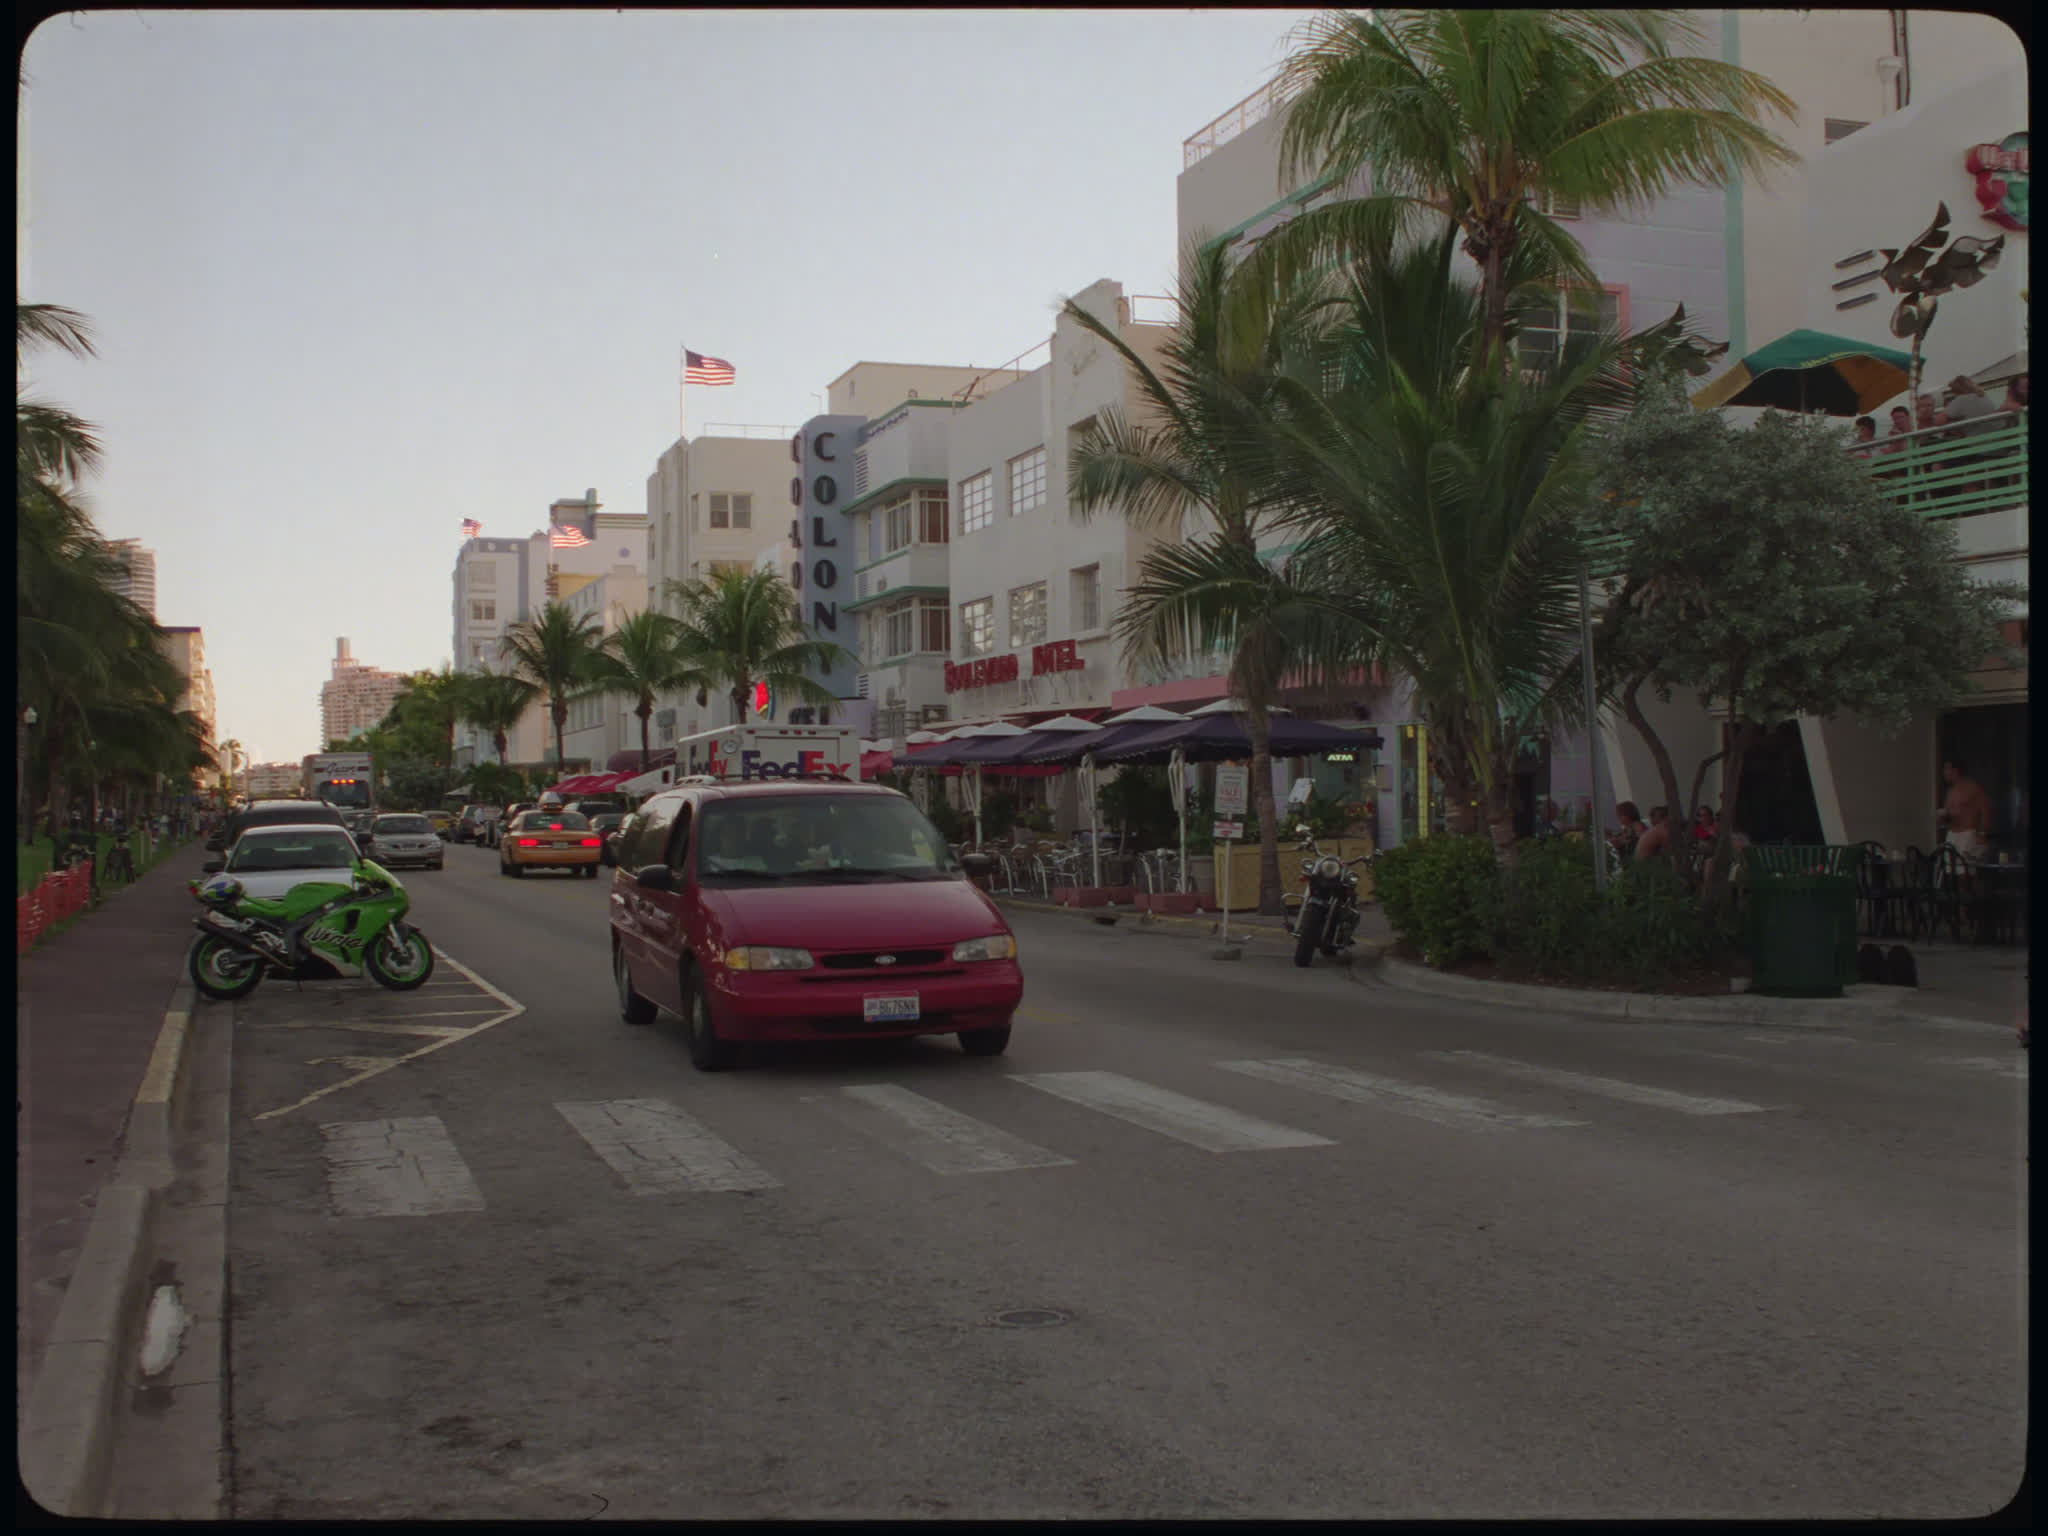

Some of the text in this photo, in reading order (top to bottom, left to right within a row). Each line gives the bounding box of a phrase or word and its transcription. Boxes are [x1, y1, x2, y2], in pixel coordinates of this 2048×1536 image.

[742, 751, 851, 780] FedEx
[1327, 753, 1354, 762] ATM
[303, 926, 365, 950] Ninja
